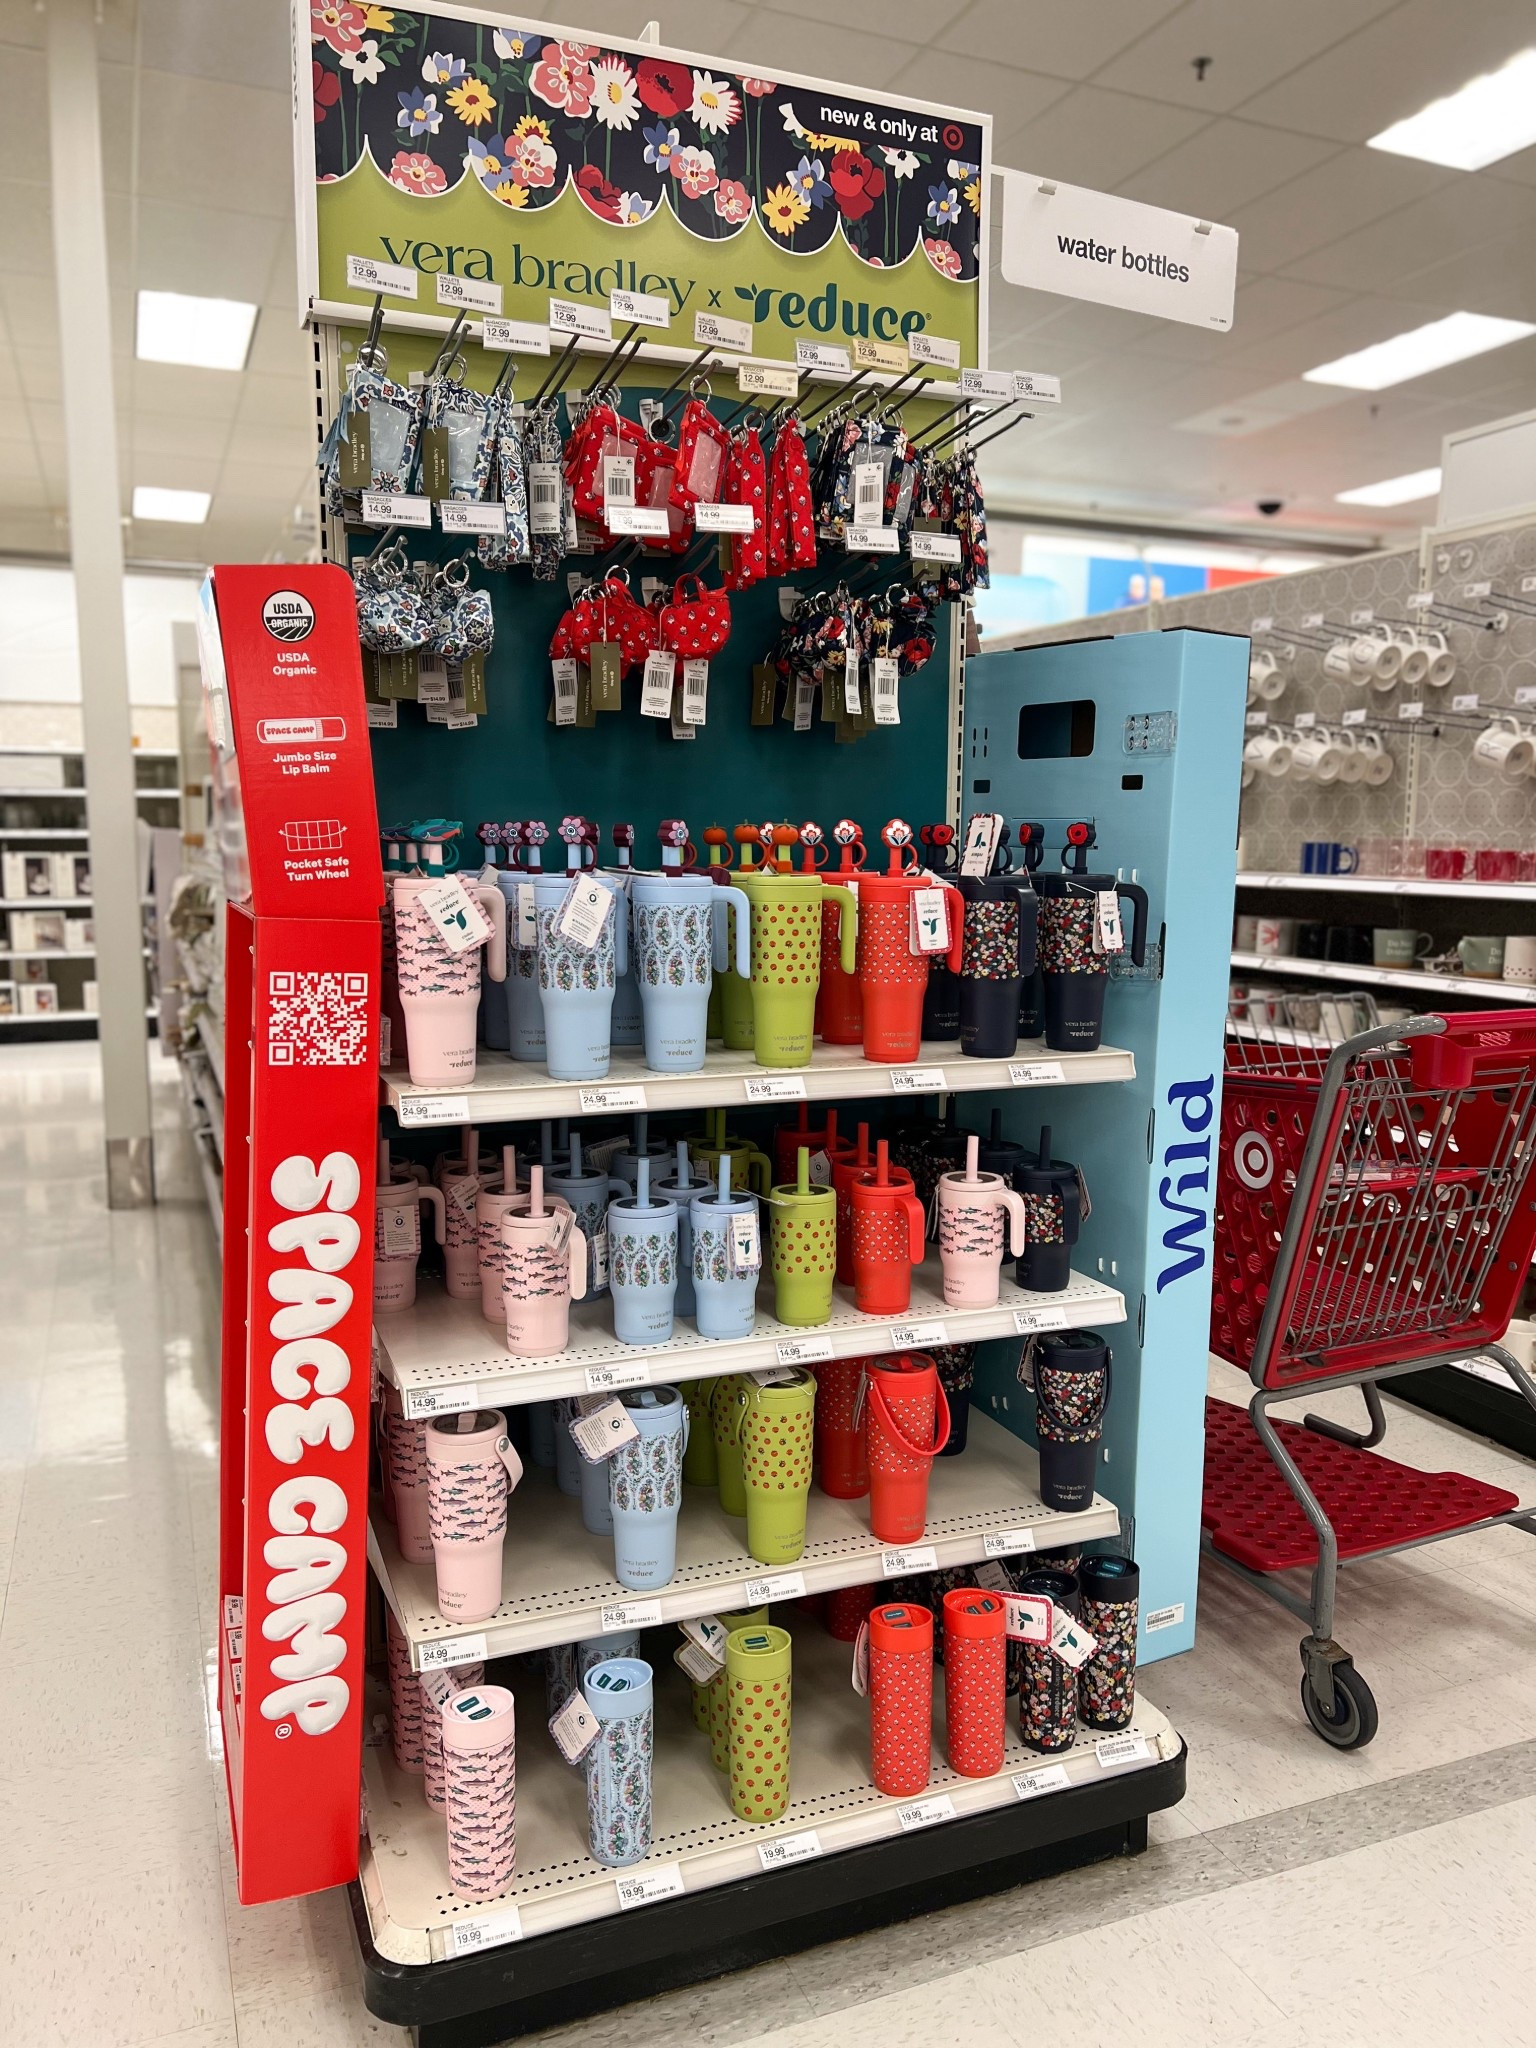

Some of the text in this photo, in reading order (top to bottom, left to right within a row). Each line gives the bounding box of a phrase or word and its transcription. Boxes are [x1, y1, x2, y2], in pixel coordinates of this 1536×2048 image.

[820, 105, 939, 143] new & only at
[1057, 234, 1190, 284] water bottles
[353, 265, 378, 279] 12.99
[379, 236, 495, 281] vera
[512, 243, 697, 317] bradley
[708, 288, 722, 309] x
[440, 284, 464, 296] 12.99
[613, 301, 634, 312] 12.99
[554, 311, 577, 323] 12.99
[486, 328, 510, 338] 12.99
[698, 325, 719, 336] 12.99
[858, 347, 877, 358] 12.99
[913, 343, 931, 353] 12.99
[799, 350, 819, 360] 12.99
[744, 374, 765, 384] 12.99
[964, 379, 982, 389] 12.99
[1016, 381, 1033, 391] 12.99
[351, 431, 359, 458] bradley
[368, 504, 392, 514] 14.99
[445, 513, 468, 522] 14.99
[699, 511, 720, 520] 14.99
[849, 534, 869, 543] 14.99
[914, 542, 932, 551] 14.99
[273, 603, 303, 616] USDA
[271, 617, 308, 629] ORGANIC
[276, 653, 310, 664] USDA
[272, 665, 317, 677] Organic
[266, 725, 315, 736] SPACE CAMP
[272, 750, 337, 763] Jumbo Size
[282, 763, 330, 776] Lip Balm
[284, 857, 349, 870] Pocket Safe
[287, 869, 349, 882] Turn Wheel
[440, 899, 460, 914] reduce
[665, 1047, 693, 1057] reduce
[1012, 1069, 1032, 1078] 24.99
[893, 1077, 915, 1086] 24.99
[749, 1085, 772, 1094] 24.99
[583, 1095, 607, 1104] 24.99
[402, 1107, 428, 1116] 24.99
[1157, 1073, 1215, 1295] Wild
[265, 1151, 361, 1465] SPACE
[1018, 1316, 1037, 1325] 14.99
[894, 1332, 914, 1341] 14.99
[779, 1347, 801, 1357] 14.99
[590, 1373, 613, 1384] 14.99
[411, 1397, 436, 1409] 14.99
[986, 1539, 1005, 1548] 24.99
[886, 1557, 905, 1567] 24.99
[626, 1569, 654, 1578] reduce
[749, 1586, 770, 1596] 24.99
[604, 1611, 626, 1622] 24.99
[423, 1648, 448, 1660] 24.99
[1017, 1779, 1037, 1790] 19.99
[901, 1810, 922, 1821] 19.99
[763, 1847, 785, 1860] 19.99
[621, 1886, 644, 1898] 19.99
[457, 1931, 482, 1945] 19.99
